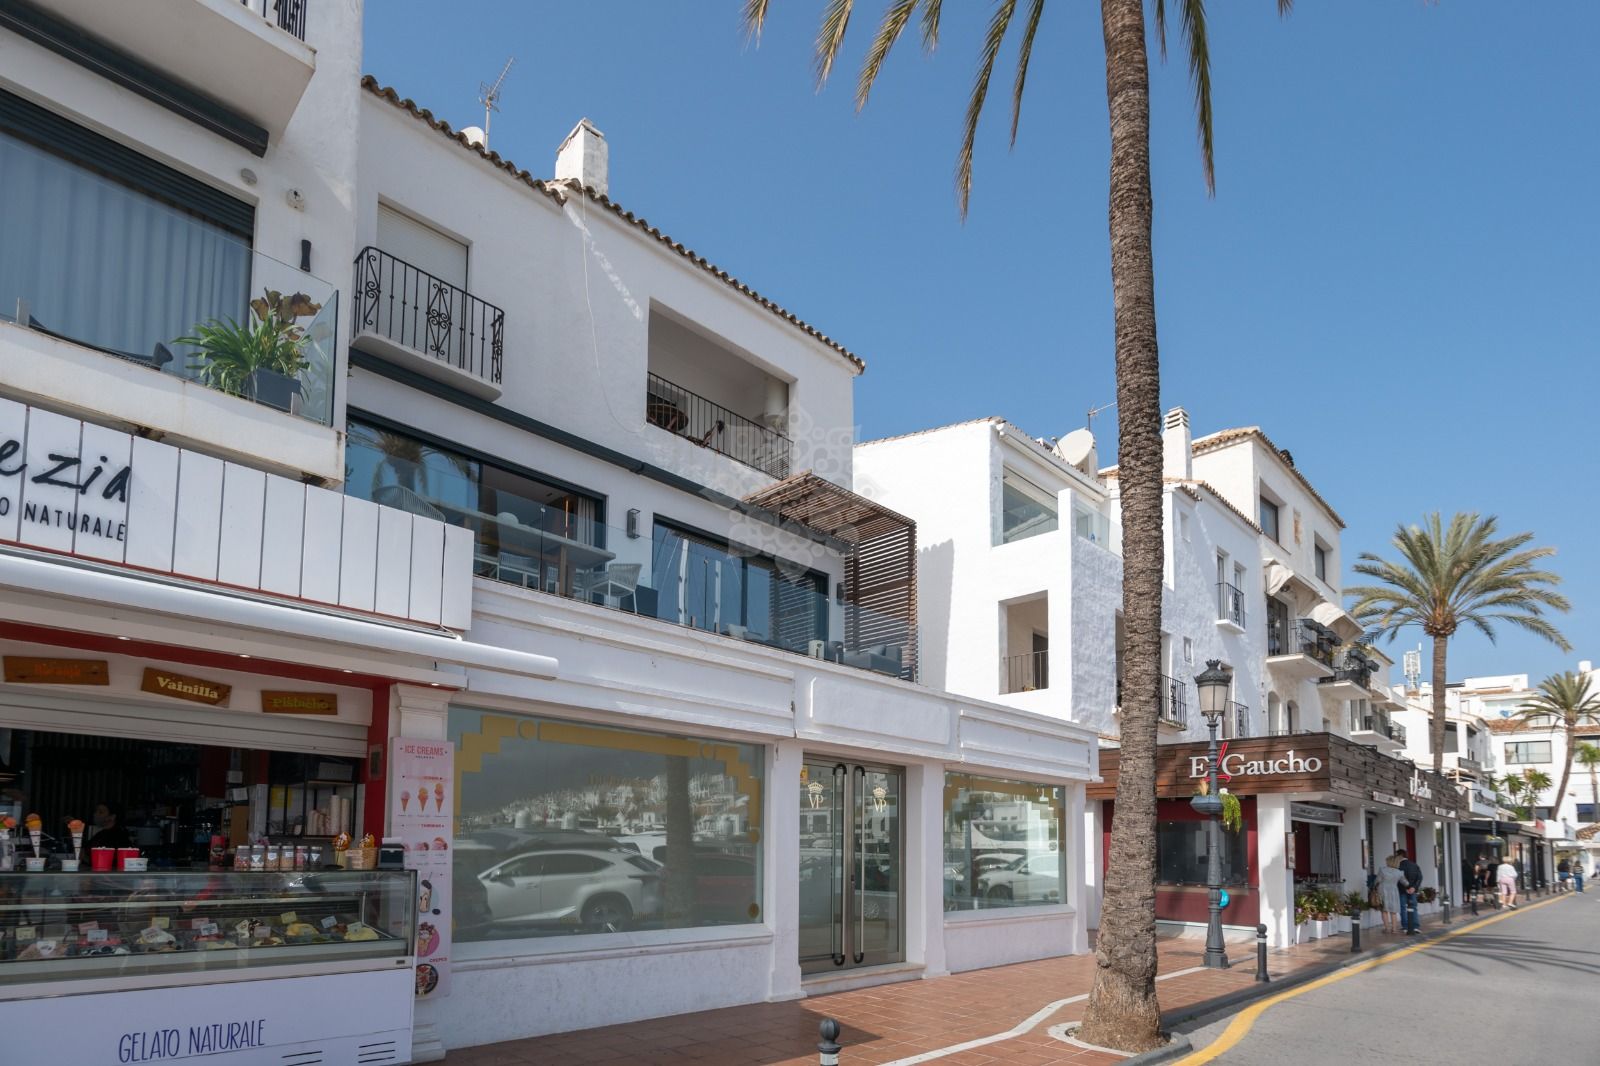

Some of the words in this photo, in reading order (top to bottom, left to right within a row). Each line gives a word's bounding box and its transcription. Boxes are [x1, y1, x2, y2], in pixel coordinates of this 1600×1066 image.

[24, 503, 126, 541] NATURALE
[157, 676, 218, 699] Vainilla
[404, 745, 415, 754] ICE
[417, 746, 444, 756] CREAMS
[1222, 750, 1322, 776] Gaucho
[118, 1029, 180, 1063] GELATO
[188, 1018, 266, 1054] NATURALE
